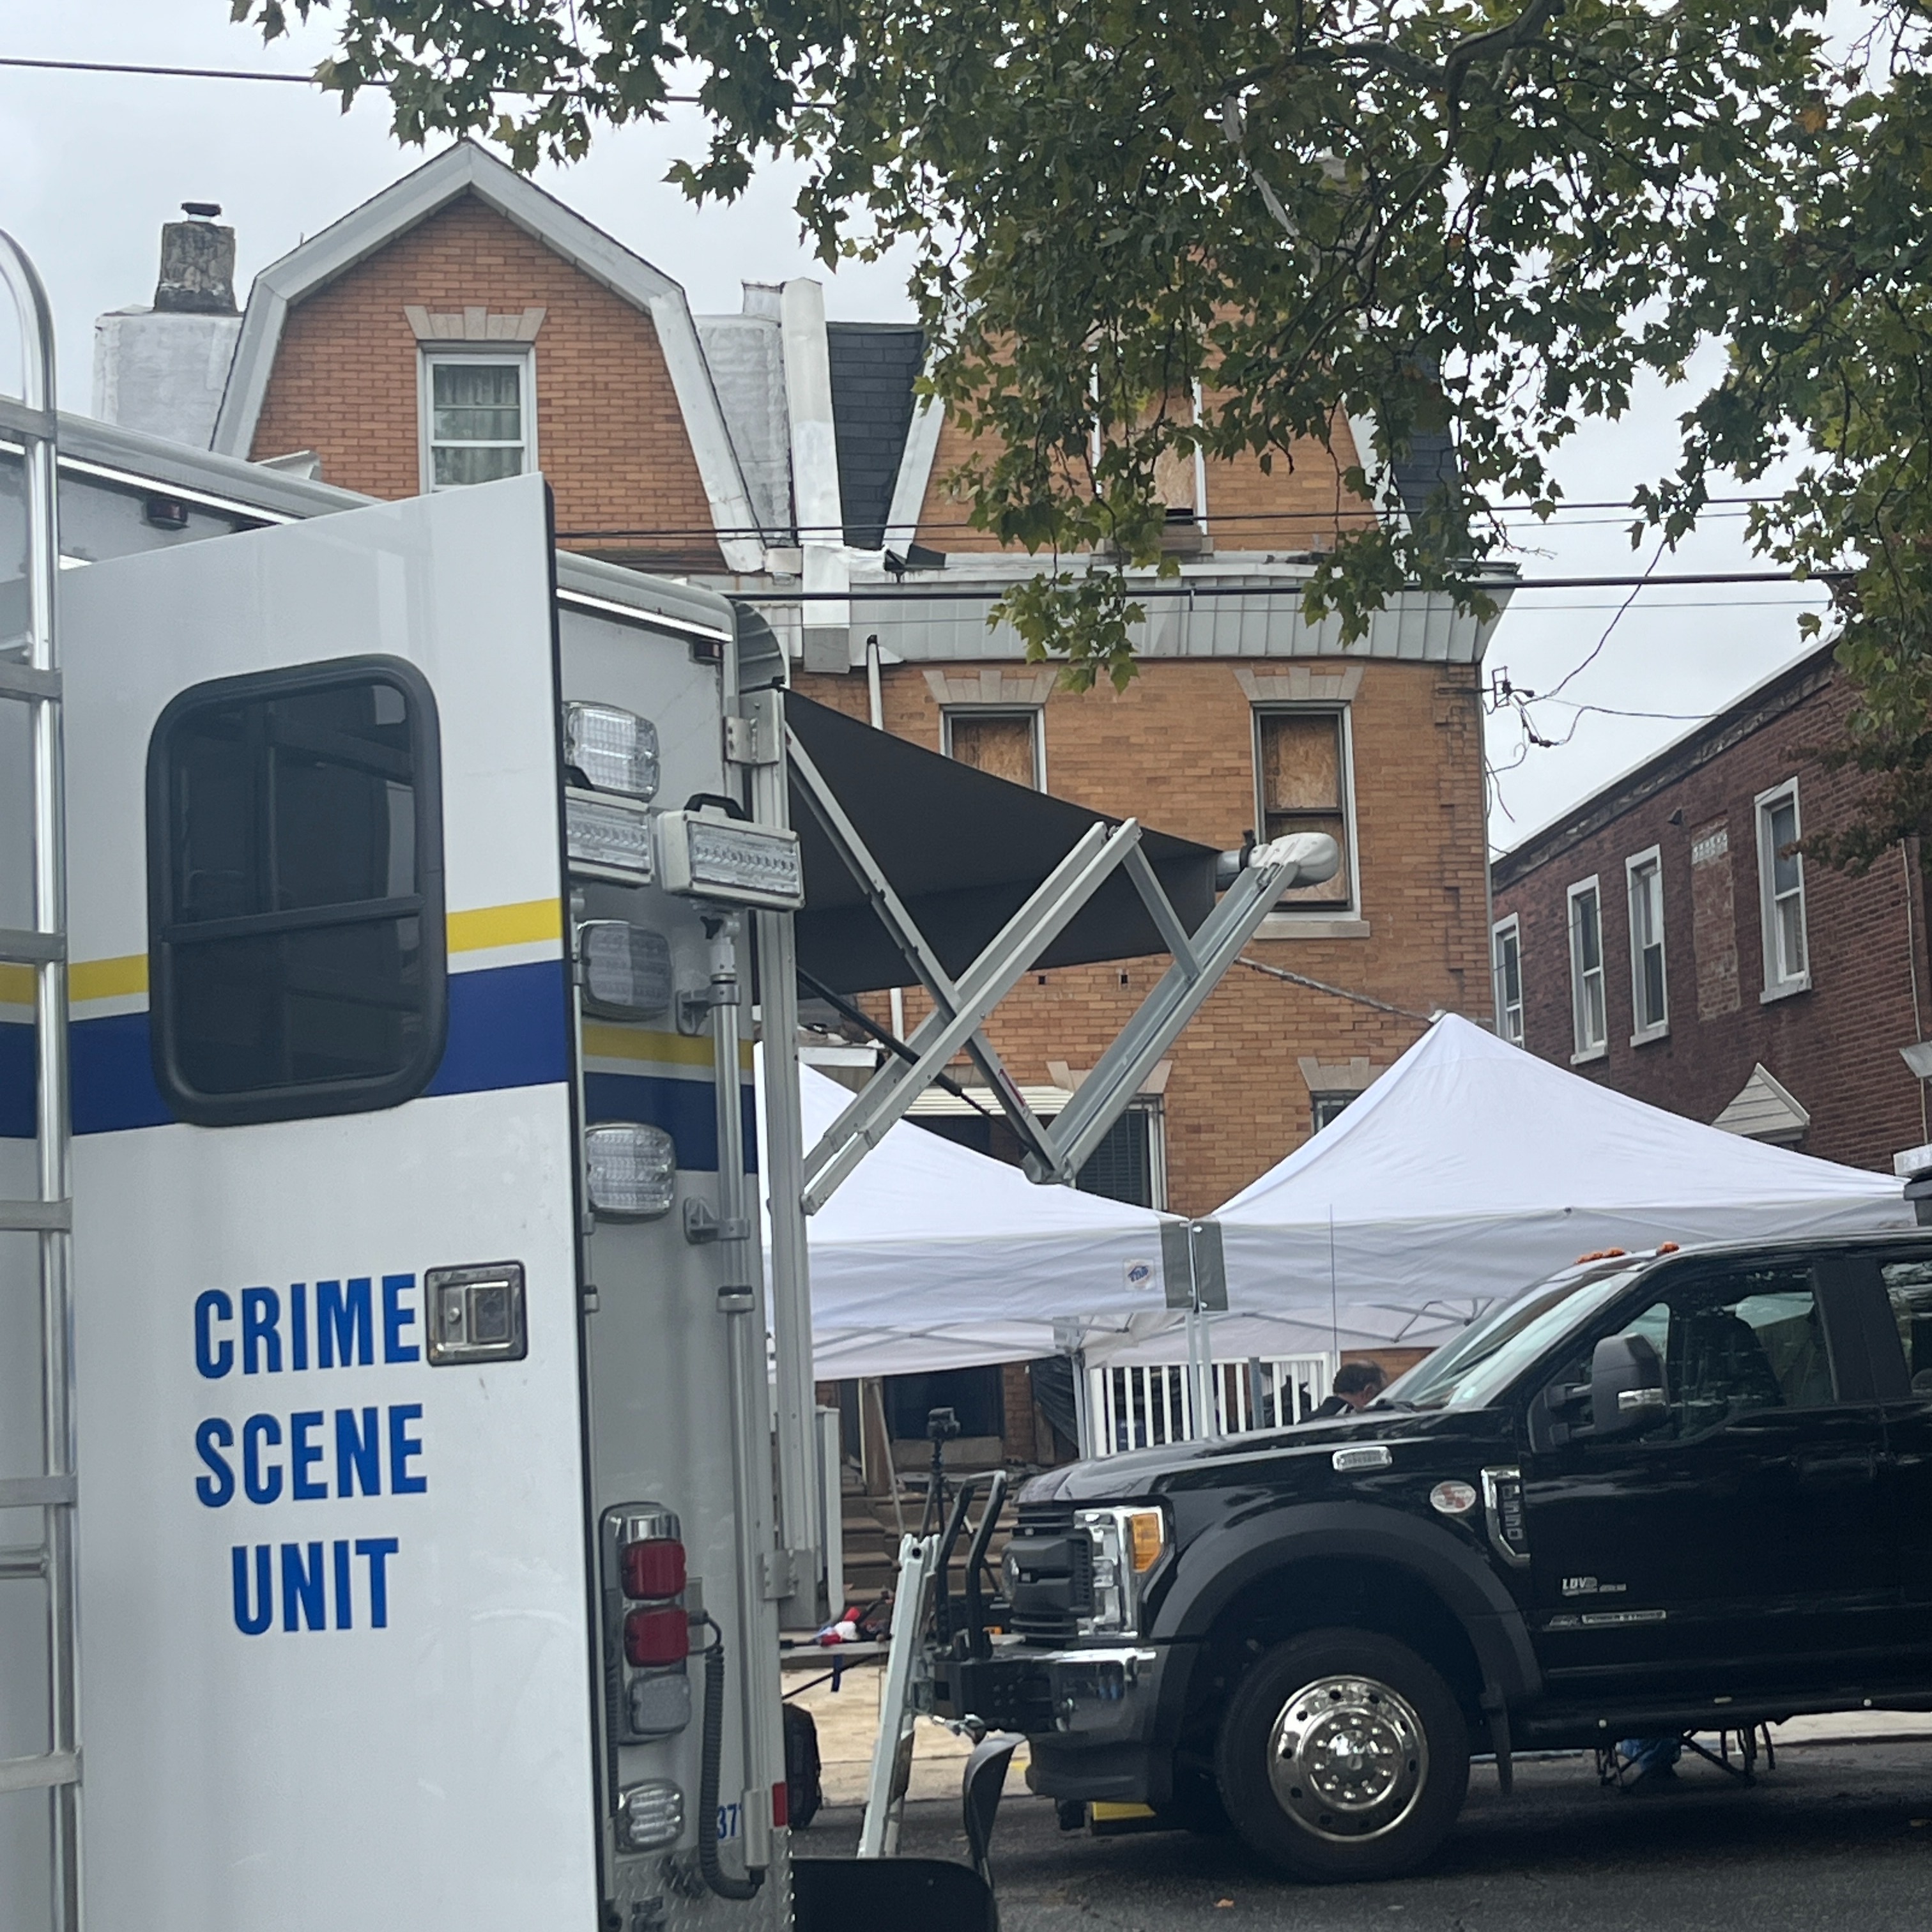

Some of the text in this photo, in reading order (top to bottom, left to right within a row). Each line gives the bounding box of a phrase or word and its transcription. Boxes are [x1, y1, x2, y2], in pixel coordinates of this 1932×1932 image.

[194, 1273, 420, 1379] CRIME
[195, 1404, 427, 1508] SCENE
[232, 1537, 399, 1635] UNIT
